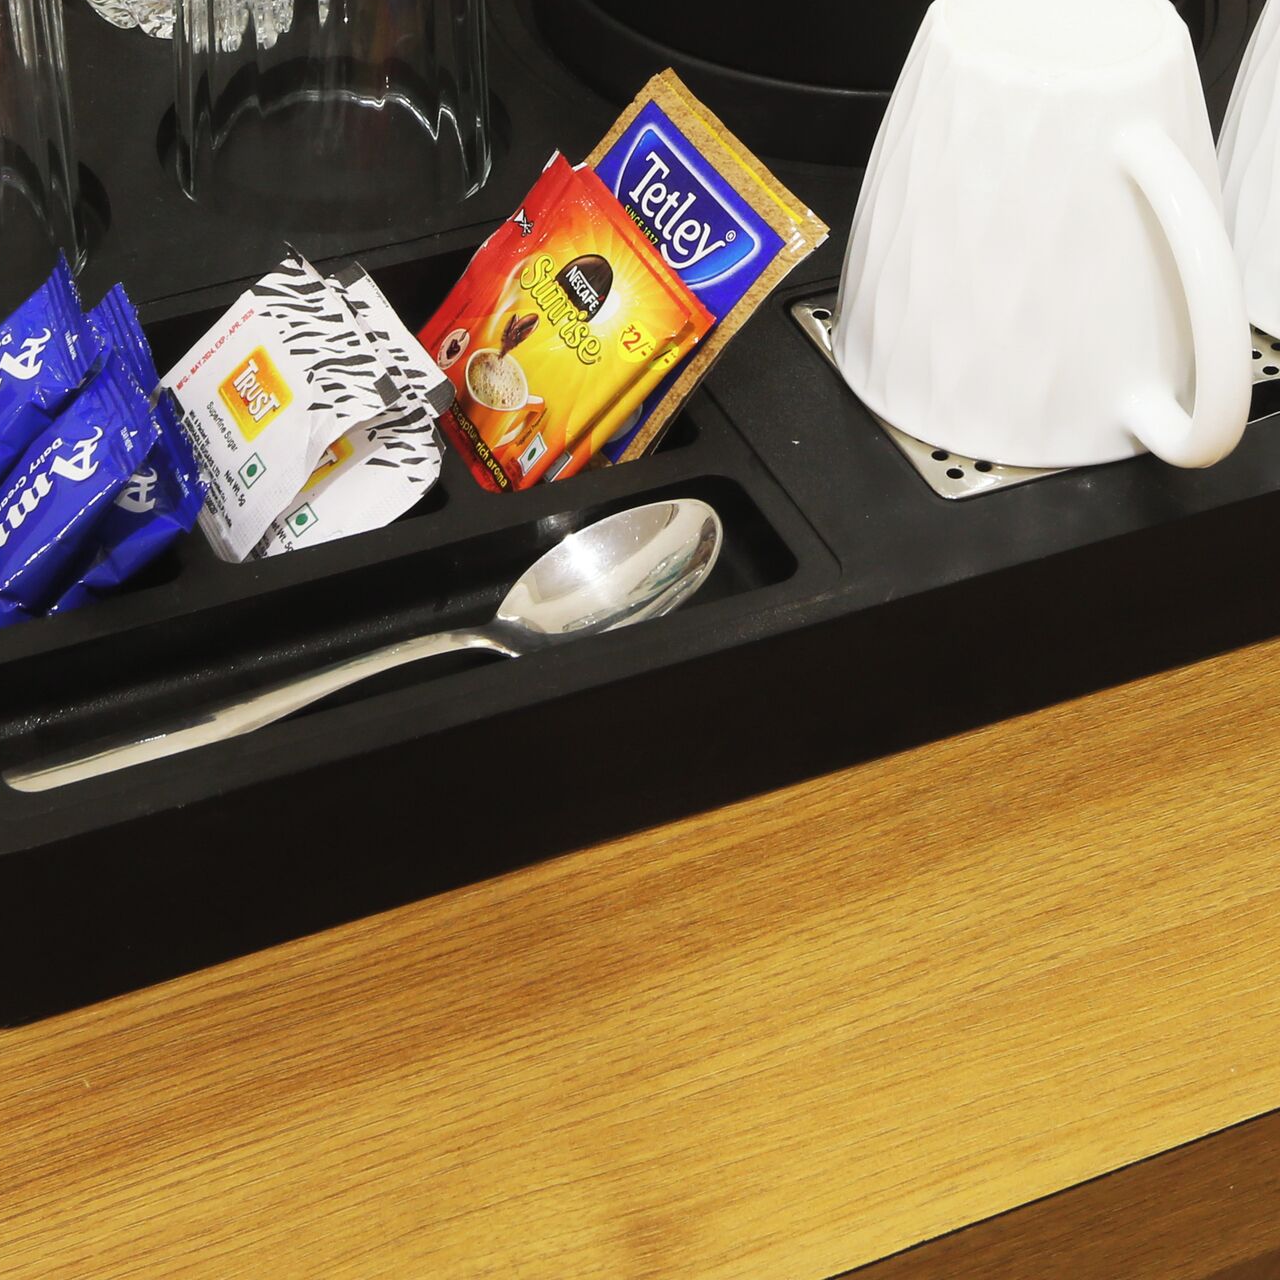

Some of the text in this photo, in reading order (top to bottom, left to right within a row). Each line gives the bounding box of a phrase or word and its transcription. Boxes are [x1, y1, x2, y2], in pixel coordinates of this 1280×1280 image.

[624, 204, 644, 230] SINCE
[629, 151, 726, 270] Tetley
[520, 253, 602, 365] Sunrise
[232, 358, 281, 424] TRUST
[206, 401, 238, 452] Superfine Sugar
[29, 437, 63, 474] Dairy
[474, 440, 492, 463] rich
[484, 457, 510, 488] aroma
[223, 470, 246, 508] Net Wt. 5g
